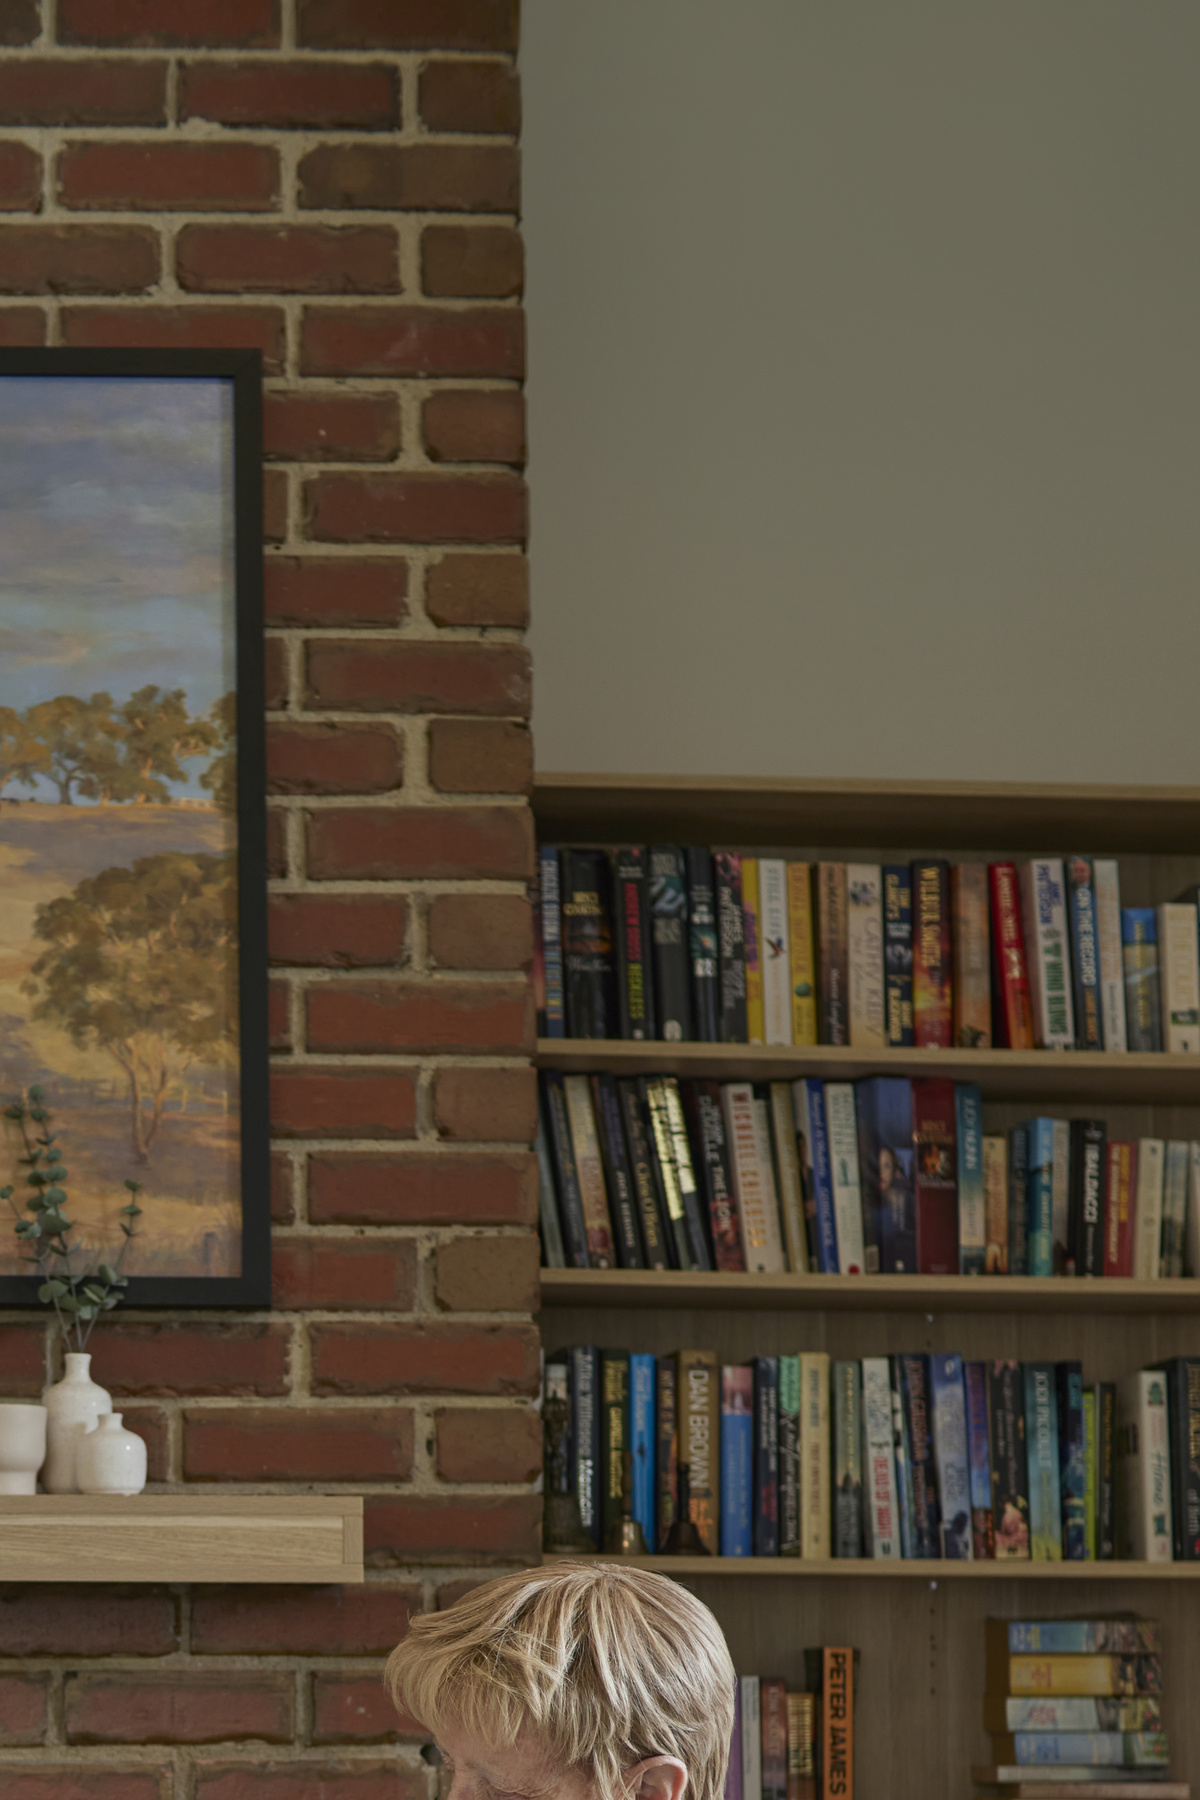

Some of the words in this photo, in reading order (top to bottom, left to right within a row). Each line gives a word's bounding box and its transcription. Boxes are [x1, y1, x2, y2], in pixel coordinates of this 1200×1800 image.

[625, 882, 640, 925] ANDREW
[920, 867, 939, 922] WILBUR
[1038, 865, 1053, 924] PATTERSON
[1051, 882, 1062, 906] JAMES
[1077, 888, 1091, 909] ON
[627, 927, 641, 961] GROSS
[719, 887, 735, 957] PATTERSON
[732, 905, 744, 943] JAMES
[1078, 910, 1093, 934] THE
[865, 917, 881, 981] CATHY
[922, 924, 941, 968] SMITH
[1080, 935, 1096, 985] RECORD
[628, 963, 644, 1018] RECKLESS
[866, 988, 883, 1036] KELLY
[732, 1093, 755, 1158] MICHAEL
[963, 1097, 977, 1124] JUDY
[965, 1129, 977, 1169] NUNN
[636, 1162, 650, 1196] Chris
[712, 1165, 725, 1191] THE
[1084, 1153, 1099, 1222] BALDACCI
[641, 1198, 658, 1247] O'Brien
[716, 1193, 731, 1231] LION
[579, 1354, 593, 1391] Mike
[689, 1370, 709, 1411] DAN
[905, 1360, 923, 1398] JOHN
[1035, 1371, 1048, 1403] JODI
[579, 1394, 593, 1457] Willesee
[910, 1399, 929, 1461] GRISHAM
[1037, 1406, 1051, 1467] PICOULT
[689, 1415, 709, 1488] BROWN
[874, 1456, 889, 1487] DEAD
[579, 1459, 594, 1527] Memoirs
[878, 1505, 893, 1538] NIGHT
[830, 1653, 846, 1719] PETER
[830, 1726, 846, 1795] JAMES
